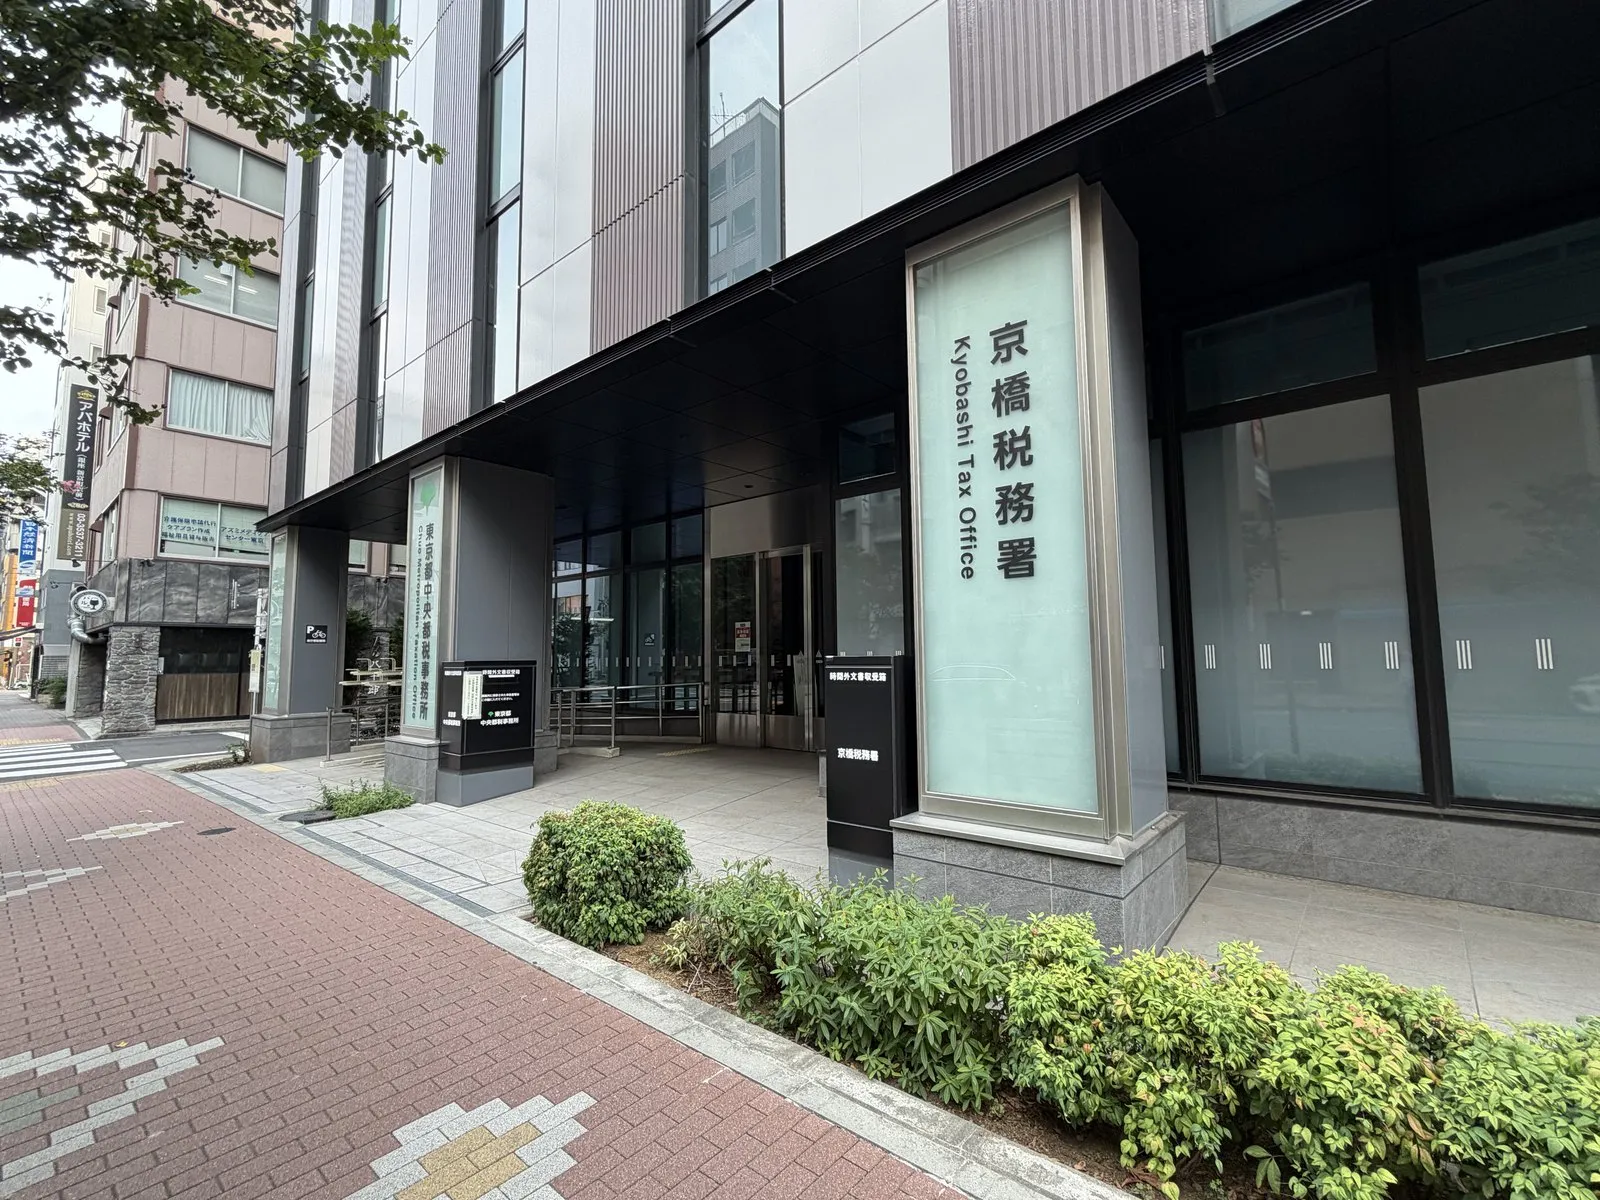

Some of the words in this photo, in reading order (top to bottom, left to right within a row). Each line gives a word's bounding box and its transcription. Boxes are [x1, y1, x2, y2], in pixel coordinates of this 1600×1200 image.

[951, 335, 974, 447] Kyobashi
[75, 401, 93, 452] アパホテル
[989, 318, 1037, 579] 京橋税務署
[957, 454, 975, 498] Tax
[74, 513, 86, 557] 03-3537-3211
[959, 507, 977, 580] Office
[307, 626, 314, 634] P
[419, 522, 434, 720] 東京都中央都税事務所
[837, 747, 879, 762] 京橋税務署
